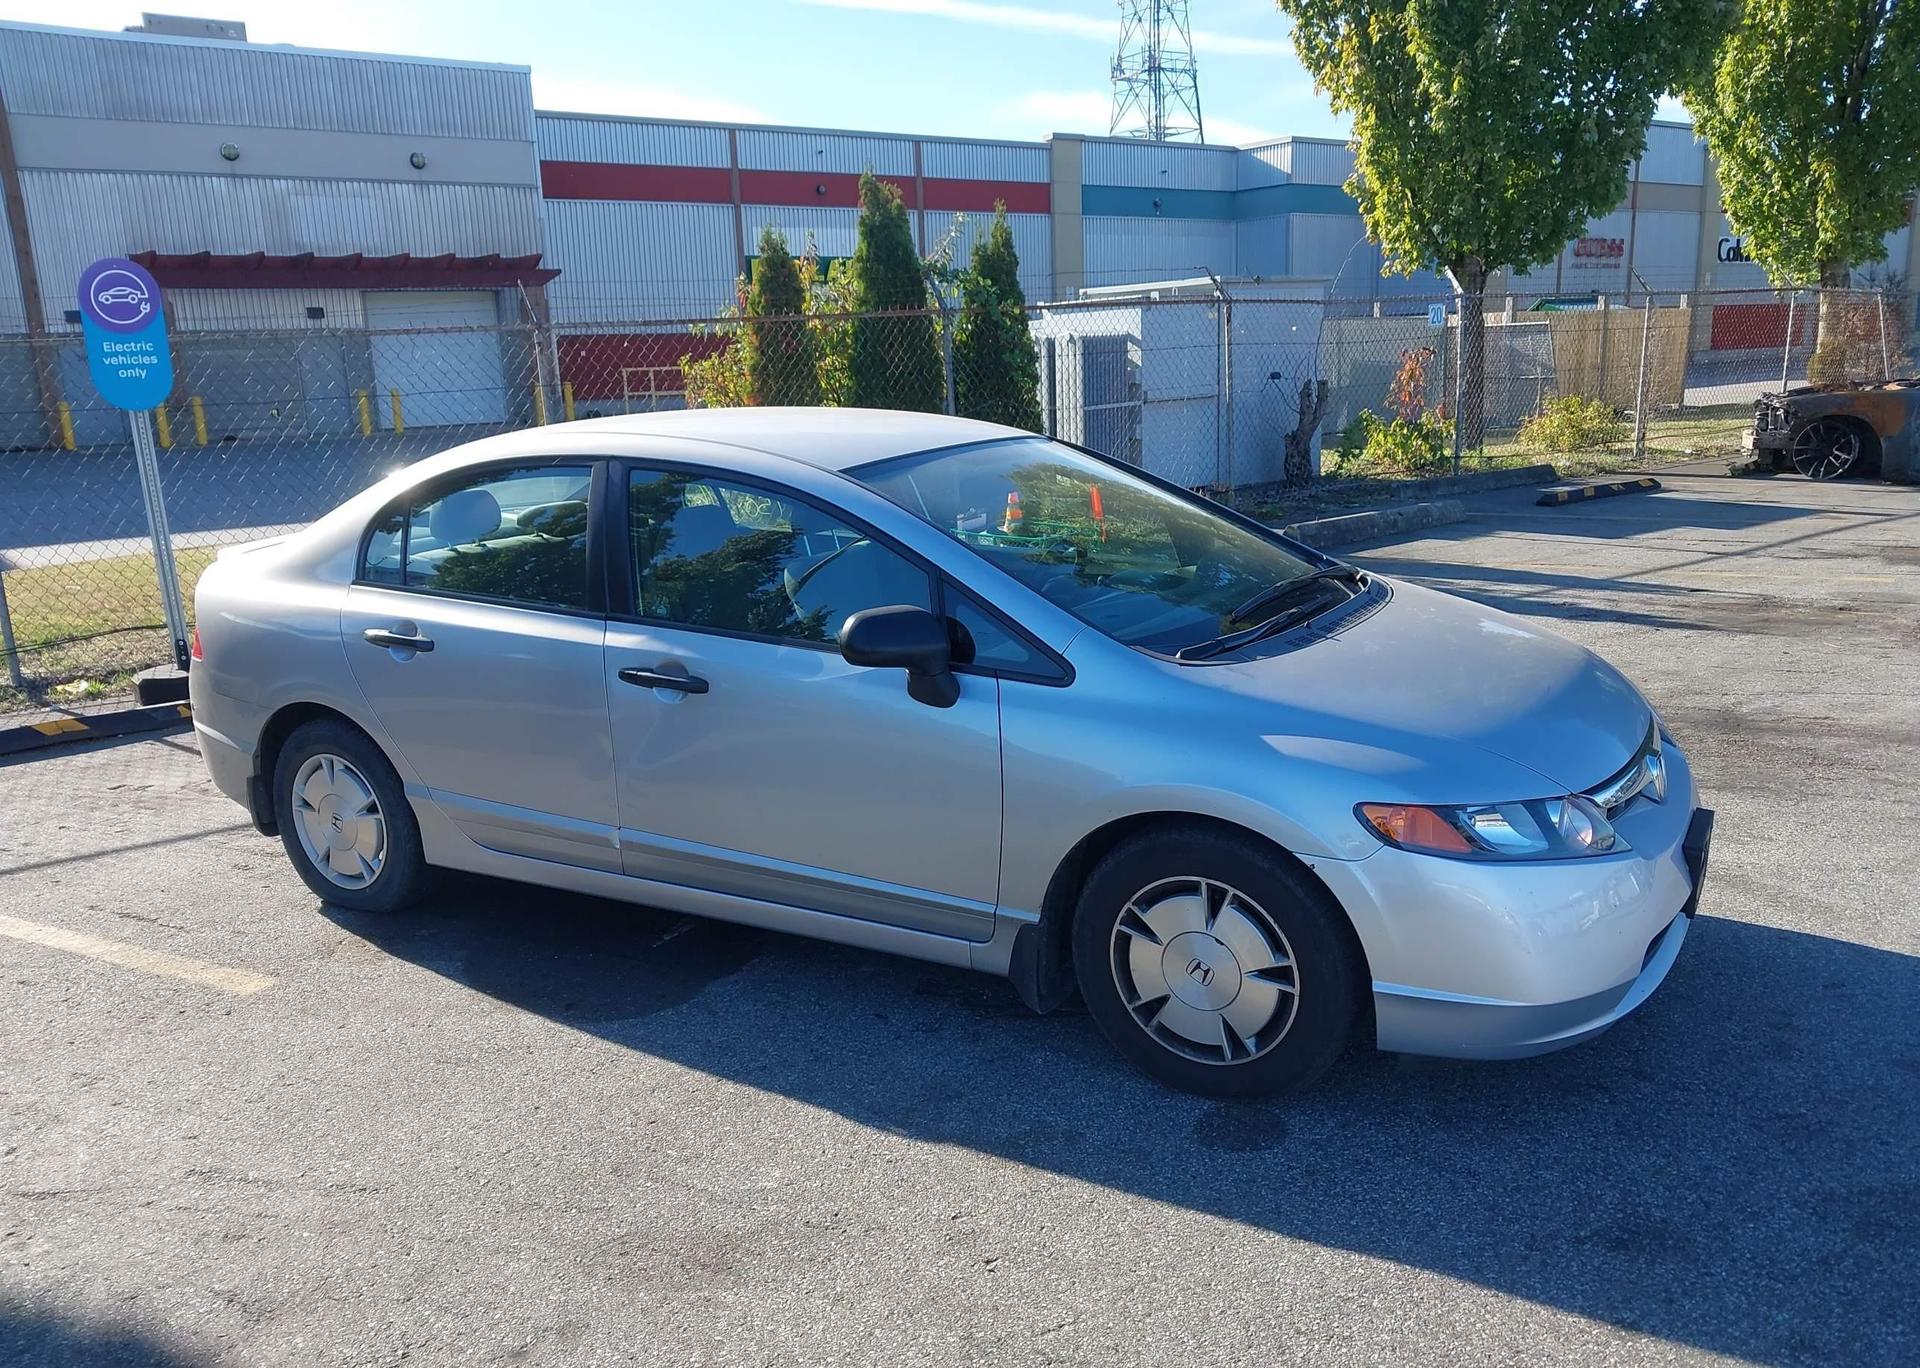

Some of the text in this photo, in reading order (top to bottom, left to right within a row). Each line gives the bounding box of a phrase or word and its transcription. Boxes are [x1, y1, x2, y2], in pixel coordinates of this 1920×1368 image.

[1430, 306, 1442, 324] 20
[103, 341, 154, 352] Electric
[103, 354, 158, 365] vehicles
[118, 367, 147, 379] only
